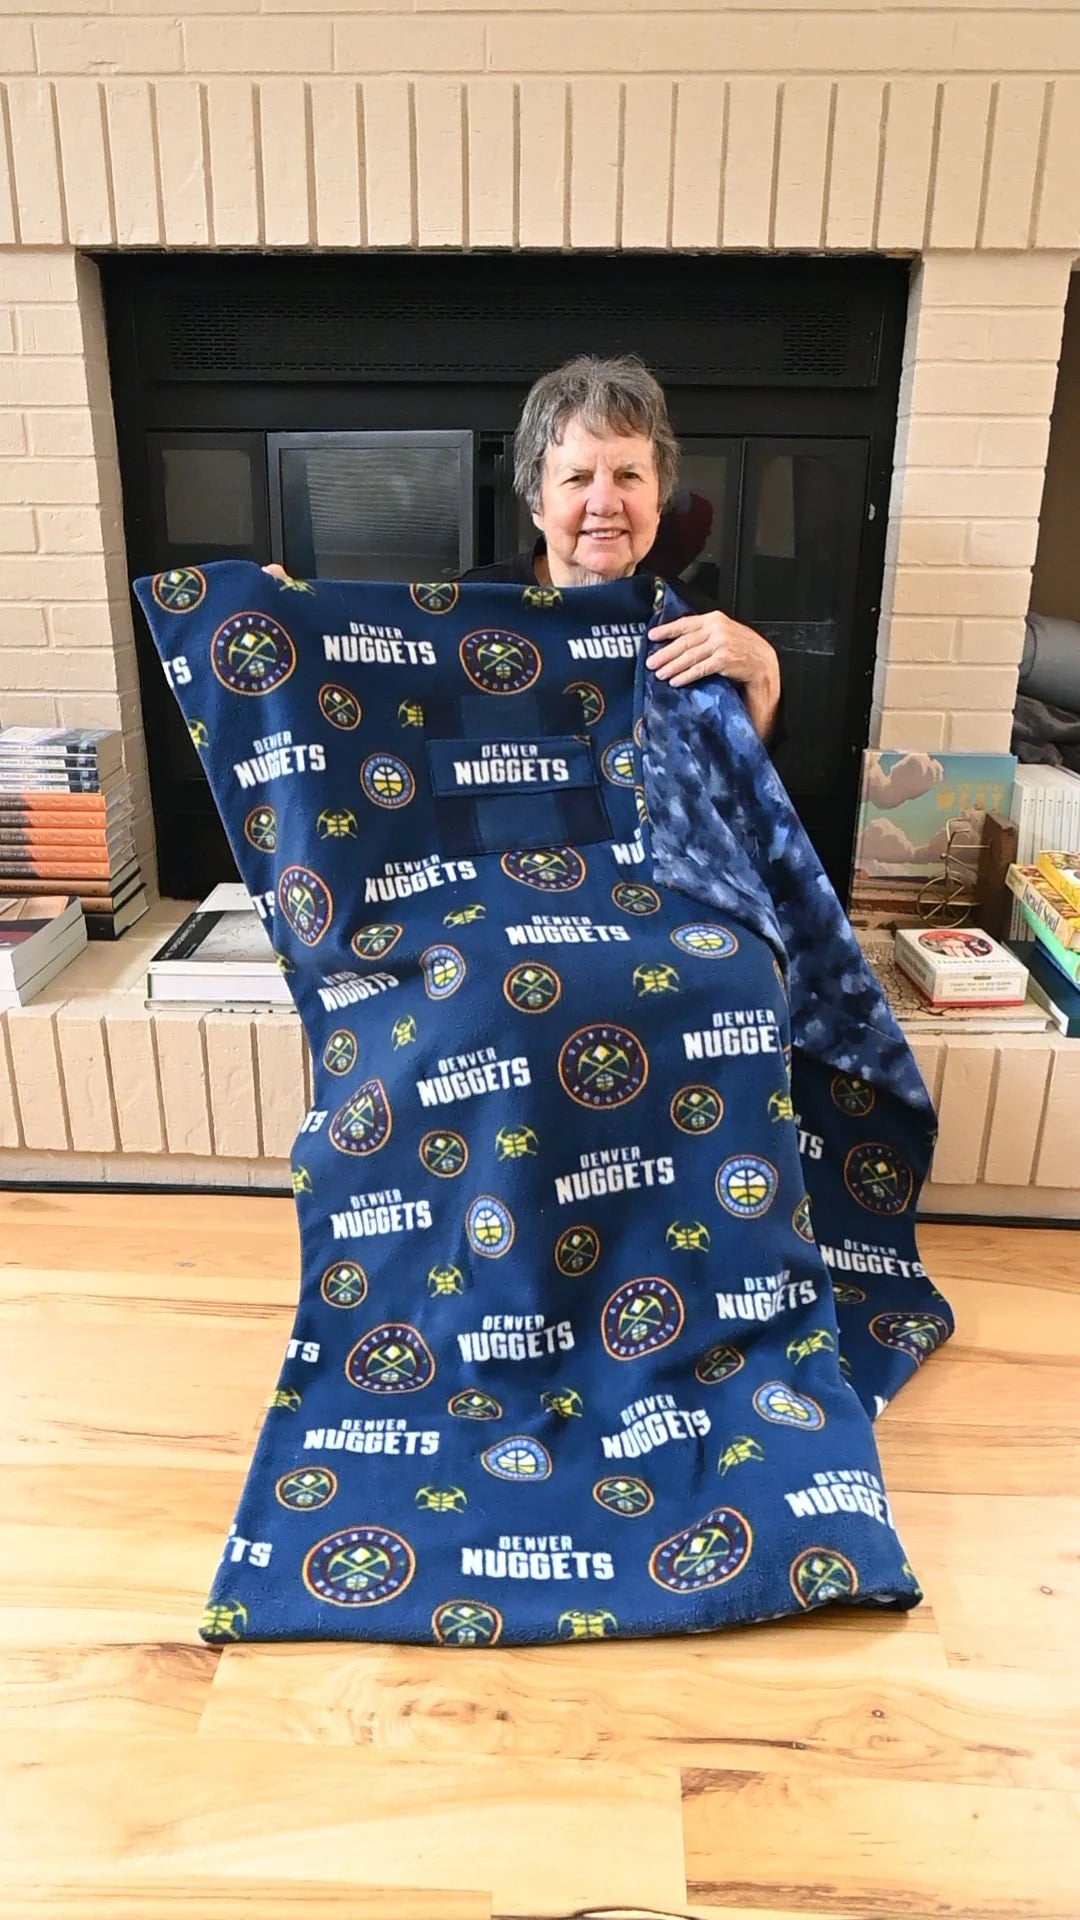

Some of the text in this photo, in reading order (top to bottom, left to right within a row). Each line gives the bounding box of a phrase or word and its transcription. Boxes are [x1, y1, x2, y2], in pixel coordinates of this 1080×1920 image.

[350, 622, 403, 639] DENVER
[323, 635, 437, 665] NUGGETS
[482, 744, 538, 758] DENVER
[454, 759, 569, 785] NUGGETS
[532, 915, 592, 926] DENVER
[505, 925, 631, 946] NUGGETS
[317, 972, 400, 1012] NUGGETS
[713, 1010, 776, 1027] DENVER
[683, 1025, 781, 1060] NUGGE
[438, 1048, 497, 1074] DENVER
[416, 1057, 532, 1107] NUGGETS
[580, 1147, 641, 1168] DENVER
[555, 1157, 675, 1204] NUGGETS
[350, 1189, 402, 1209] DENVER
[330, 1200, 433, 1239] NUGGETS
[483, 1315, 545, 1331] DENVER
[457, 1321, 575, 1363] NUGGETS
[621, 1395, 677, 1426] DENVER
[342, 1419, 407, 1431] DENVER
[601, 1409, 712, 1459] NUGGETS
[303, 1429, 440, 1455] NUGGETS
[499, 1536, 572, 1551] DENVER
[461, 1547, 615, 1580] NUGGETS
